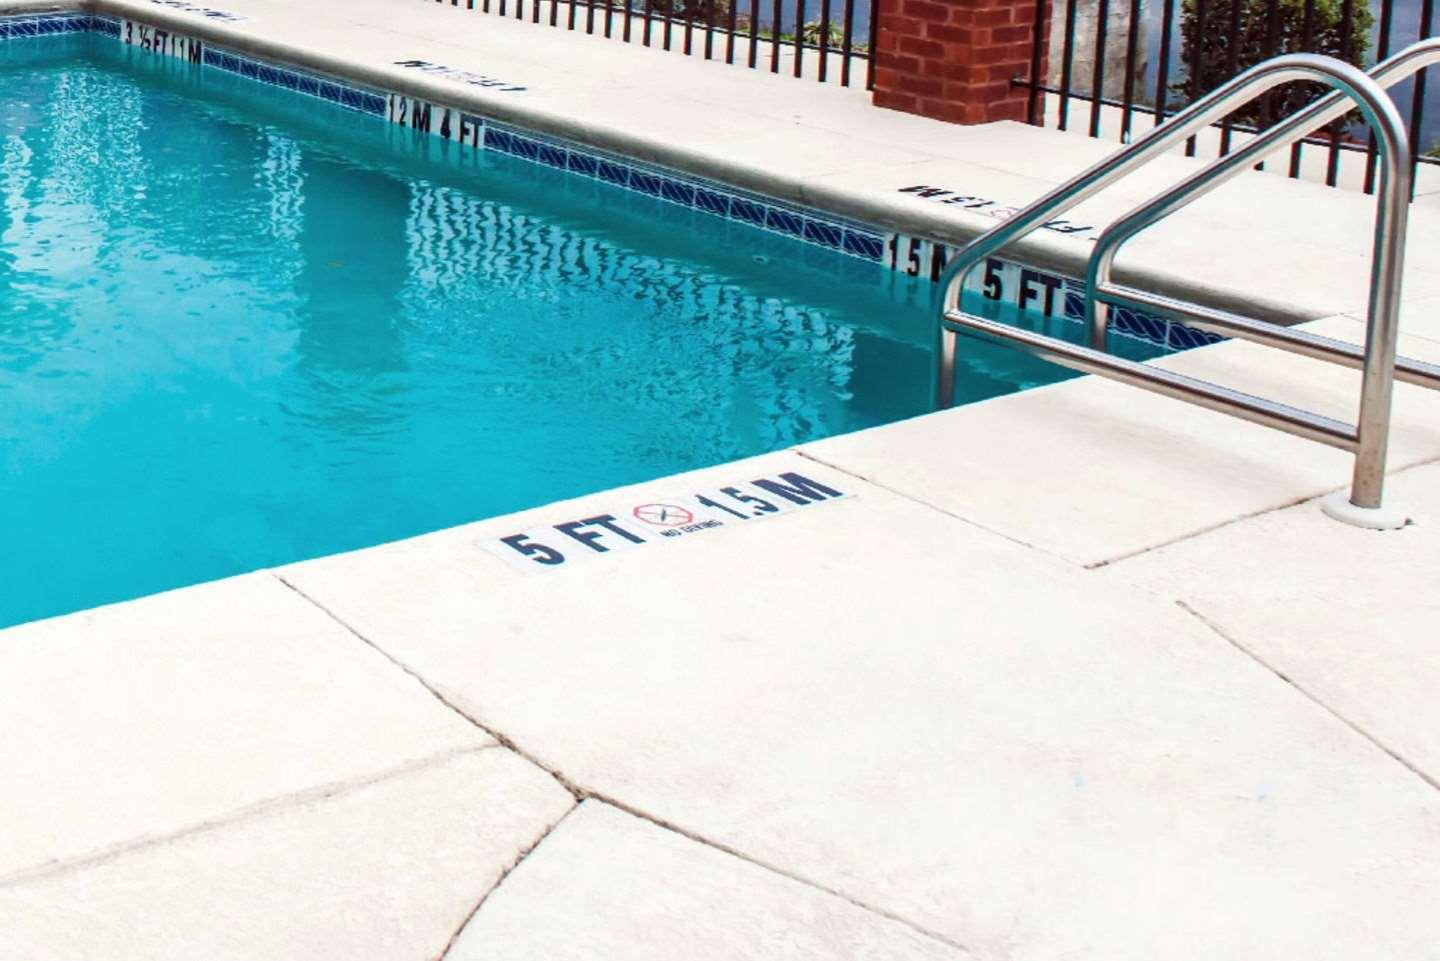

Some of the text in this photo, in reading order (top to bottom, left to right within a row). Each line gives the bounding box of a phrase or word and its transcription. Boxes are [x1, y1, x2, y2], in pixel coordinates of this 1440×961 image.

[440, 108, 452, 139] 4
[460, 112, 483, 148] FT
[982, 257, 1005, 301] 5
[1018, 268, 1062, 317] FT
[499, 514, 647, 565] 5 FT
